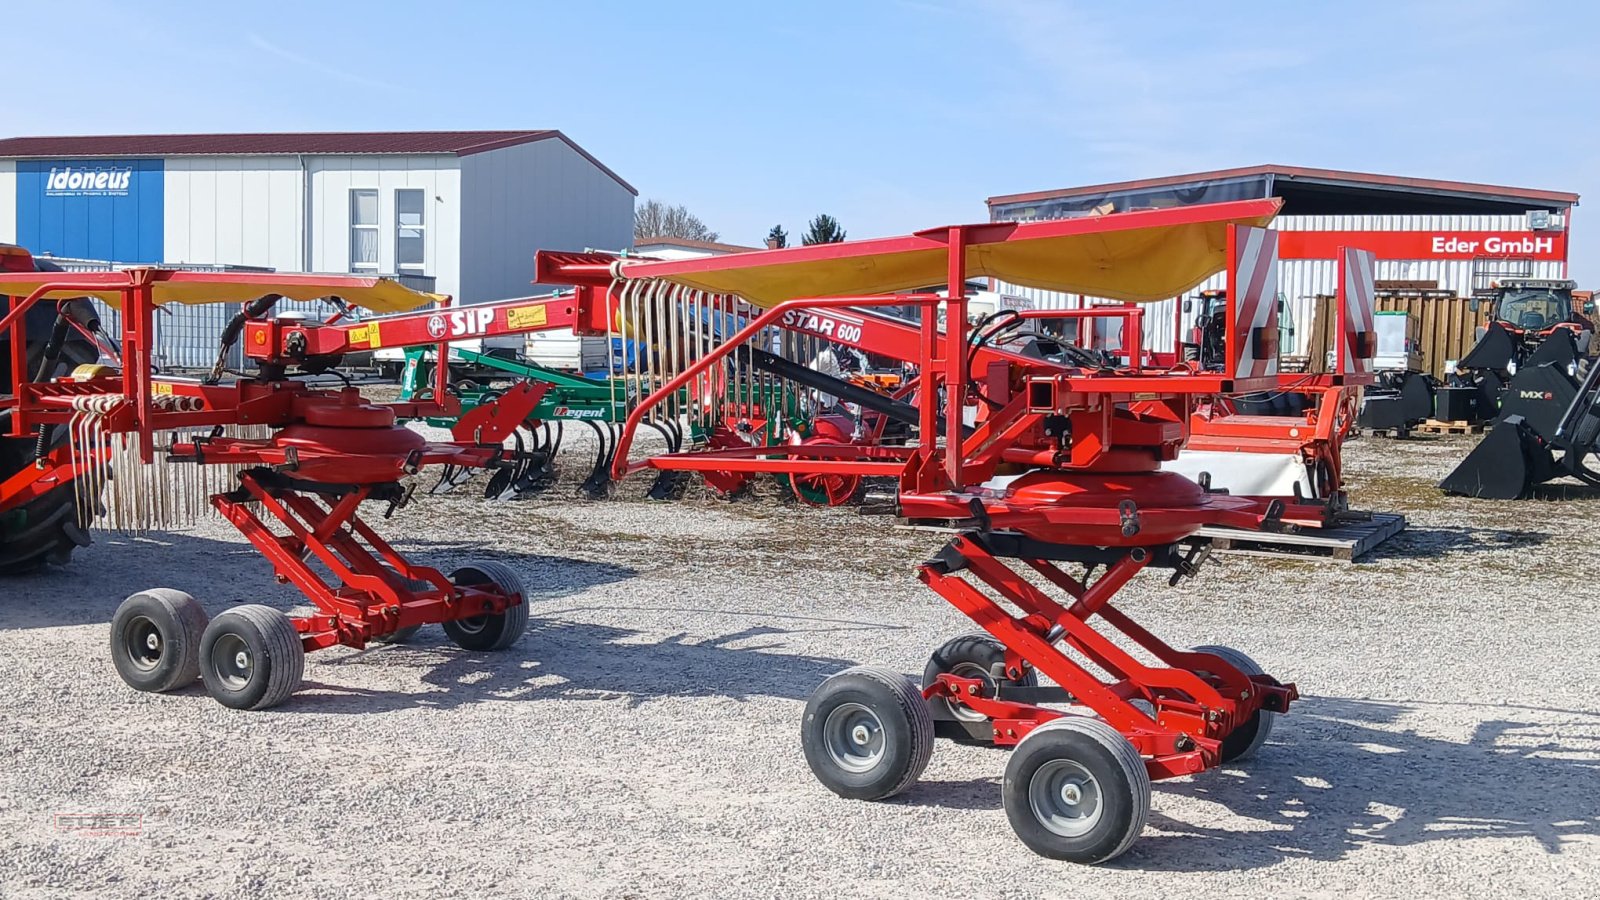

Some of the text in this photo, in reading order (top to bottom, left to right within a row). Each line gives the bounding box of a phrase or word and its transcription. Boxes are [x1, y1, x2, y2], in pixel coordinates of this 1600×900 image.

[46, 166, 132, 190] idoneus
[1432, 236, 1553, 254] Eder GmbH
[451, 308, 495, 336] SIP
[782, 309, 861, 343] STAR 600
[1520, 390, 1544, 399] MX
